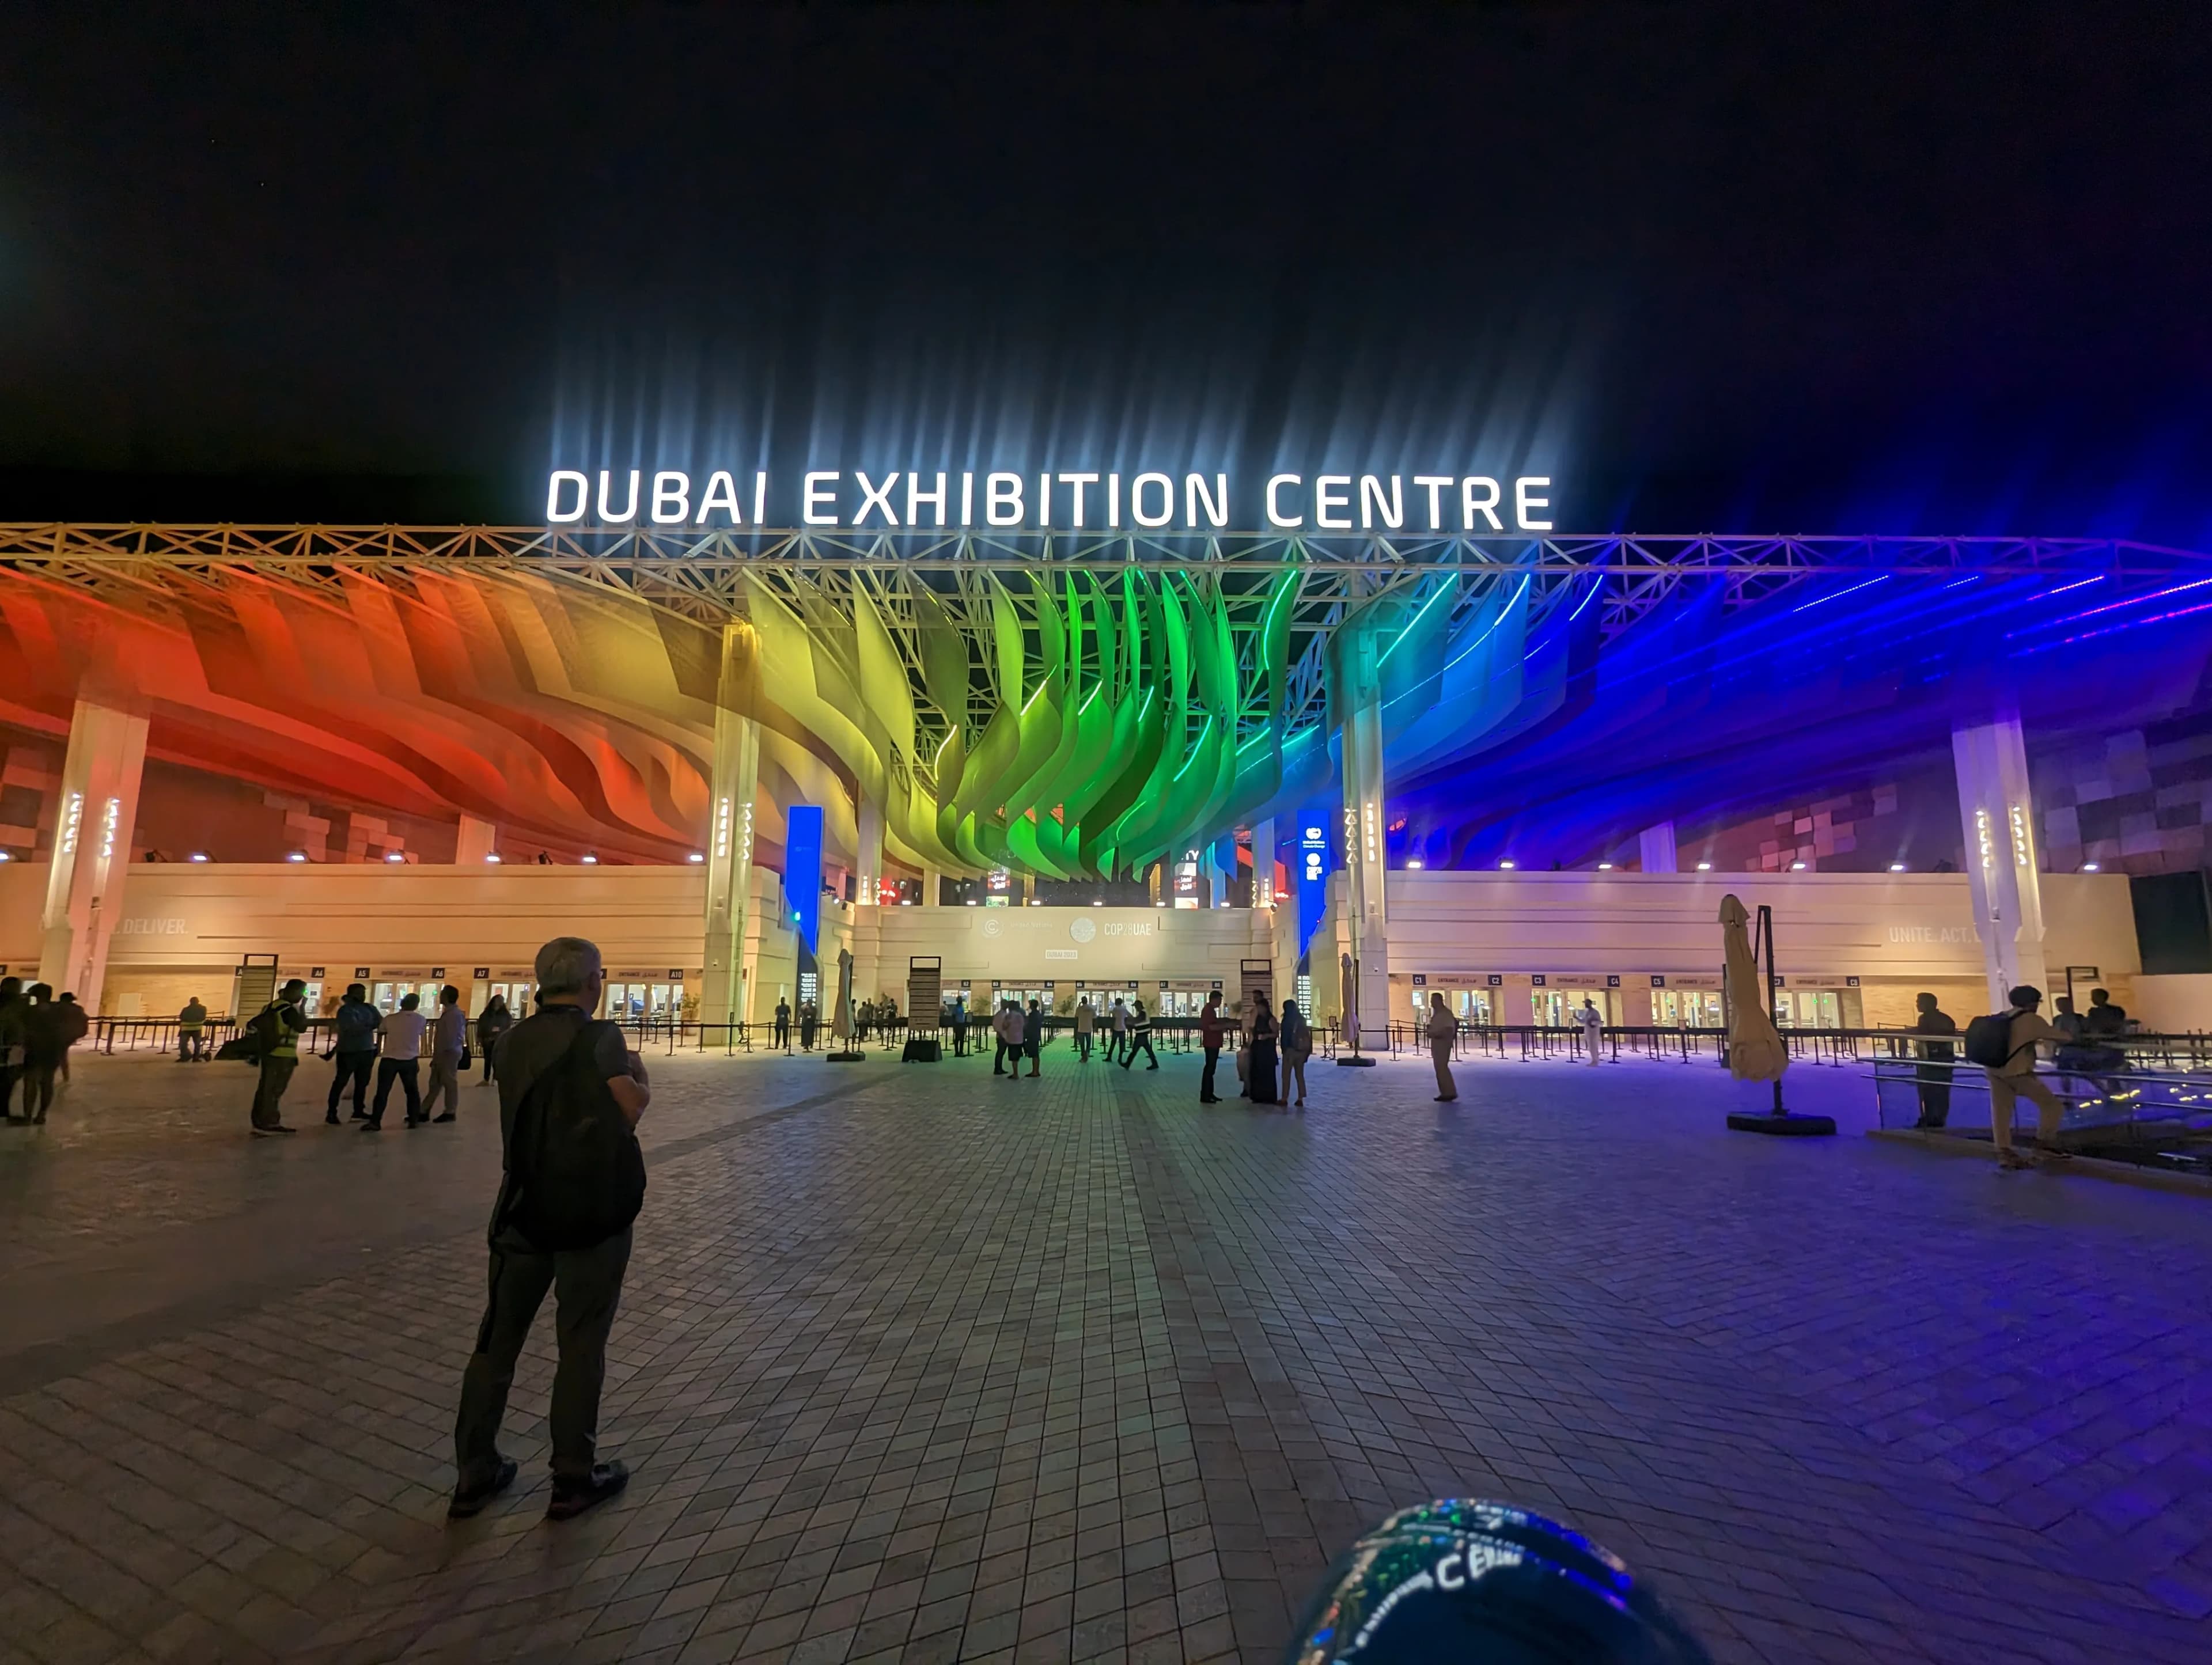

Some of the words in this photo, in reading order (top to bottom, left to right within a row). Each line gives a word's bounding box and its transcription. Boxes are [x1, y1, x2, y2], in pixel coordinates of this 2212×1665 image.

[546, 470, 767, 525] DUBAI
[804, 472, 1229, 527] EXHIBITION
[1267, 474, 1552, 530] CENTRE
[122, 919, 188, 934] DELIVER.
[1940, 927, 1972, 943] ACT.
